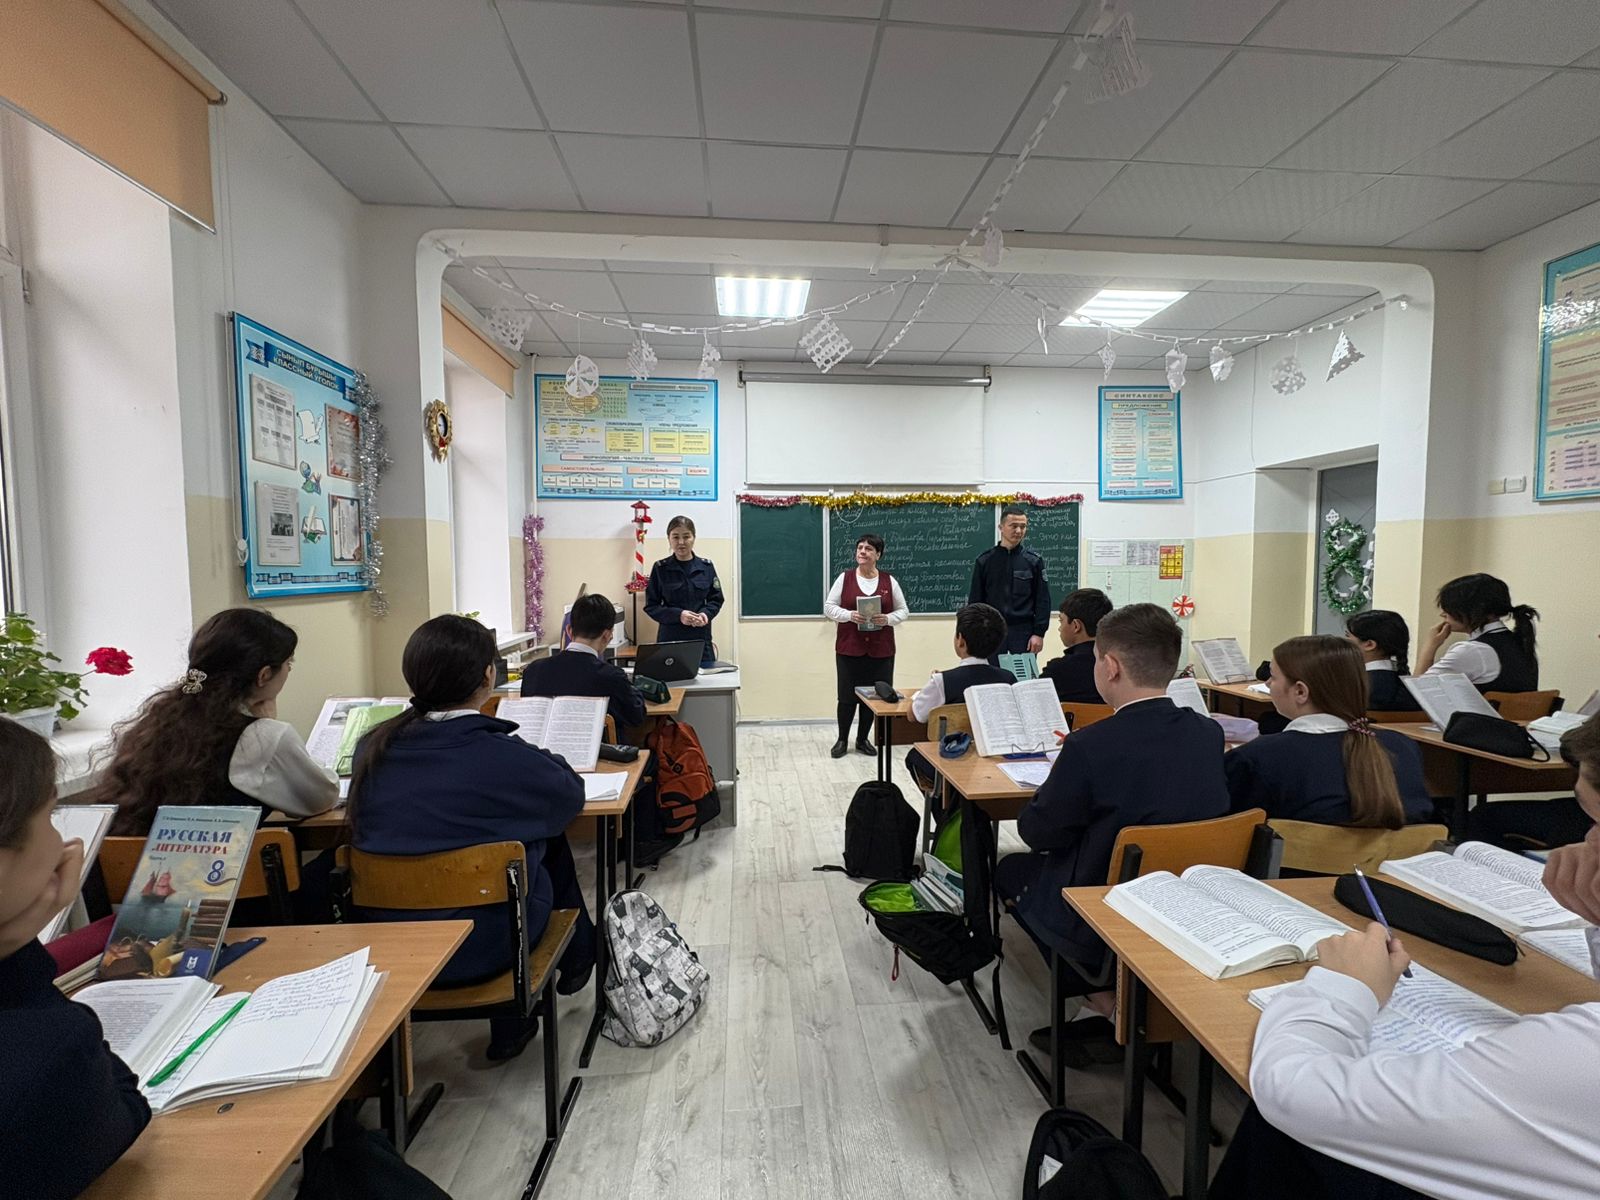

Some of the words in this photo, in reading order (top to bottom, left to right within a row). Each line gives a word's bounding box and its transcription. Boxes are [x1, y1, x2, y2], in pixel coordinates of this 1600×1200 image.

[276, 350, 305, 368] СЫНЫП
[273, 357, 314, 379] КЛАССНЫЙ
[314, 373, 340, 390] УГОЛОК
[156, 828, 233, 843] РУССКАЯ
[151, 843, 228, 855] ЛИТЕРАТУРА
[207, 859, 225, 883] 8
